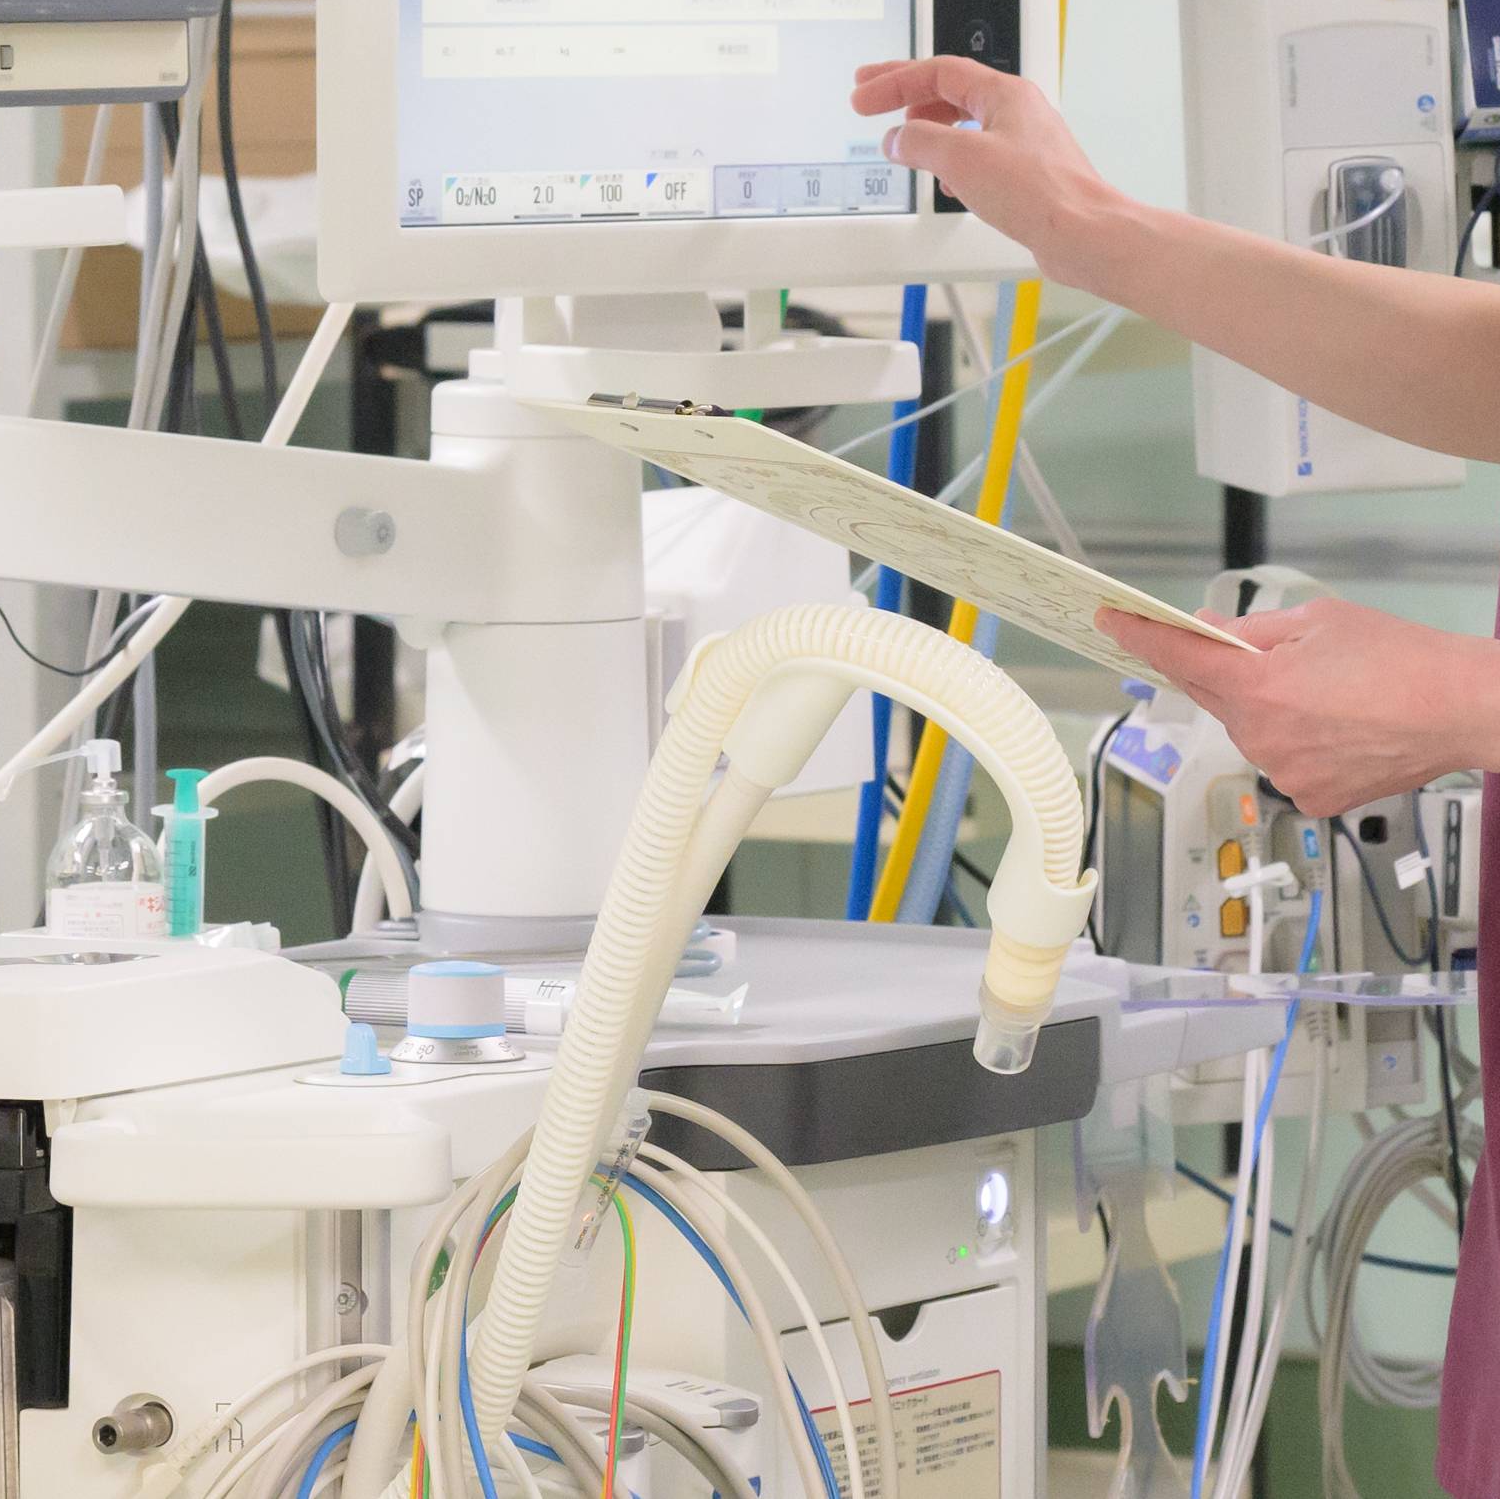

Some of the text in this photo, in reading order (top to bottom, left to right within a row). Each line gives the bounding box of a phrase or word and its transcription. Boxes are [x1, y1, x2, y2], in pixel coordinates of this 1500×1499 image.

[533, 185, 554, 205] 2.0
[600, 183, 622, 203] 100
[665, 181, 687, 201] OFF
[743, 180, 753, 200] 0
[806, 179, 820, 198] 10
[864, 177, 889, 196] 500
[408, 187, 424, 207] SP
[416, 1044, 435, 1058] 80
